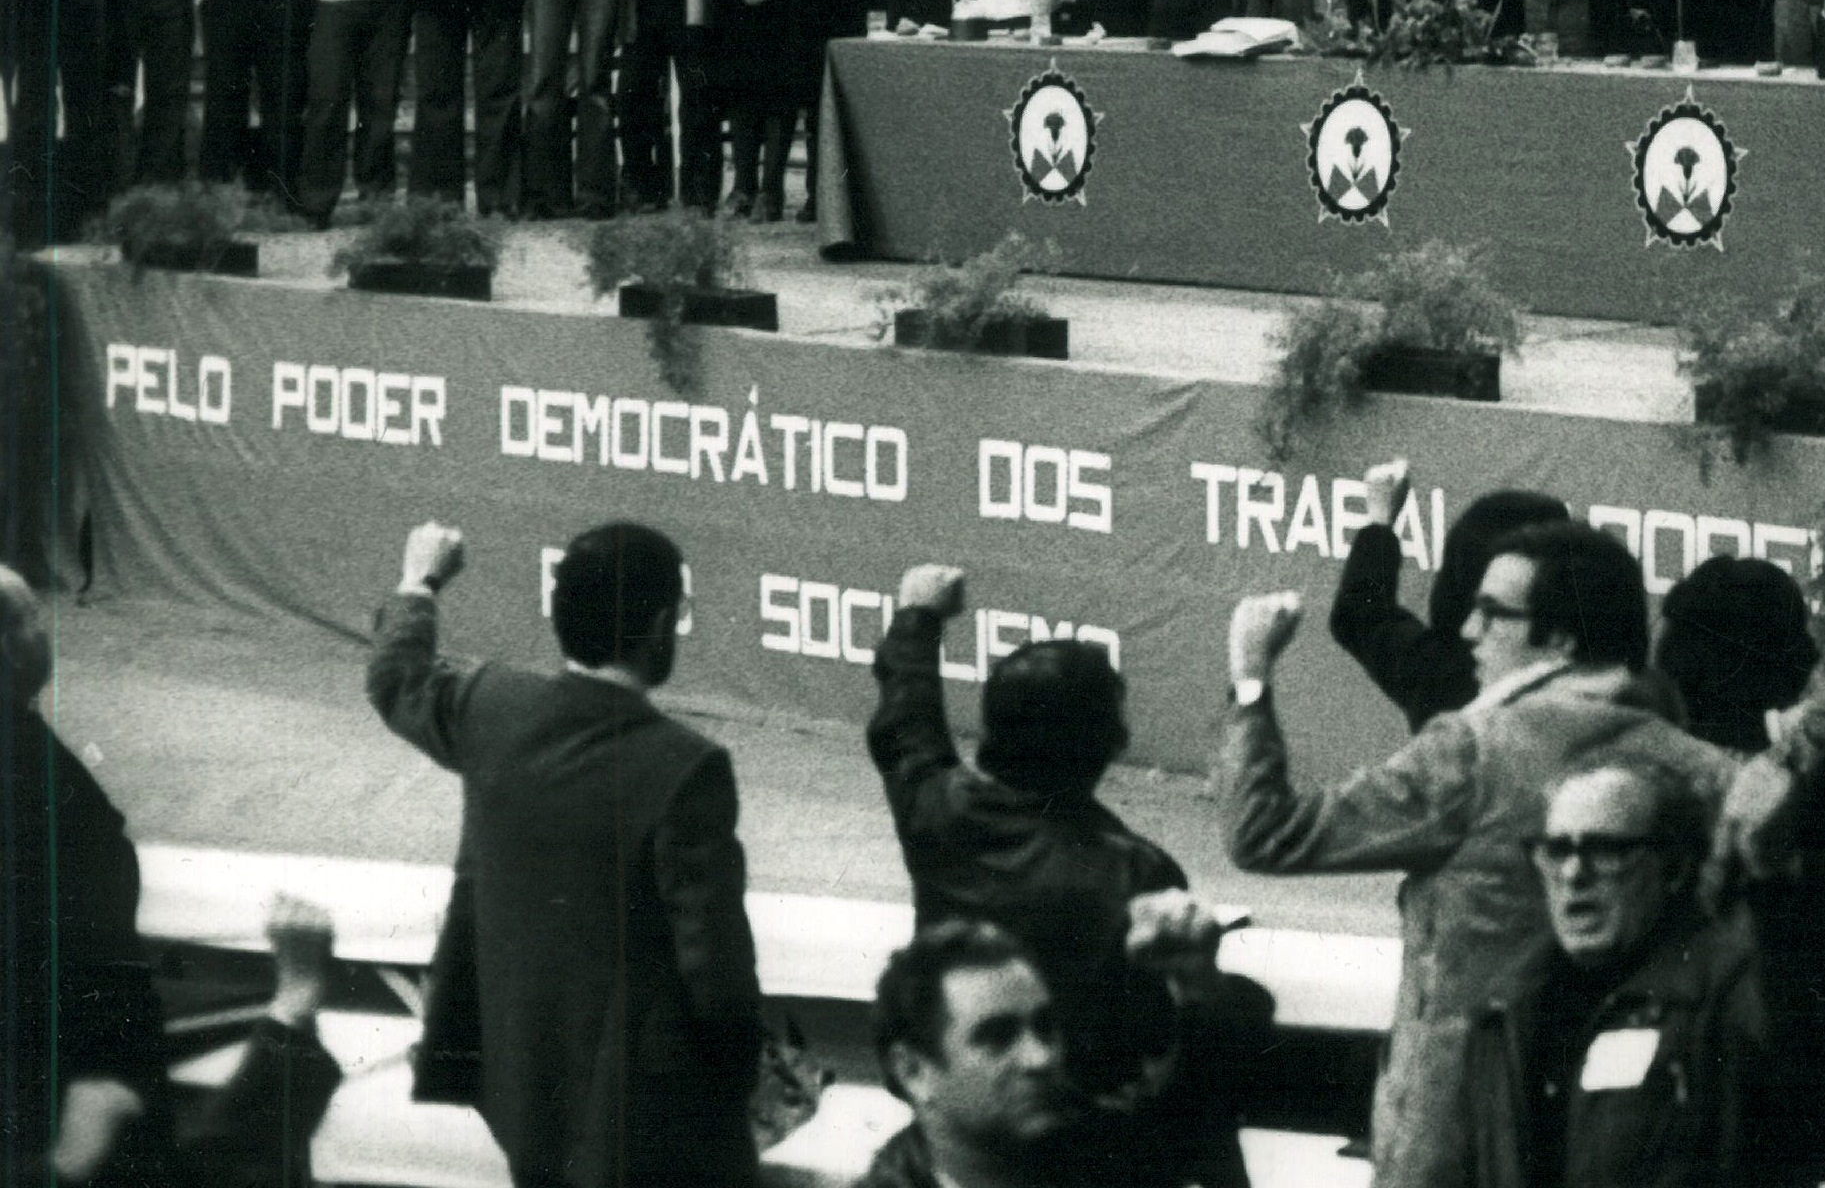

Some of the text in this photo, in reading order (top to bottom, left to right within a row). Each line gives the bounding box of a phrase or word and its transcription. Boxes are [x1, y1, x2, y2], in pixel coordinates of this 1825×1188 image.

[107, 344, 231, 424] PELO
[273, 362, 446, 445] PODER
[500, 385, 908, 501] DEMOCRÁTICO
[979, 439, 1112, 534] DOS
